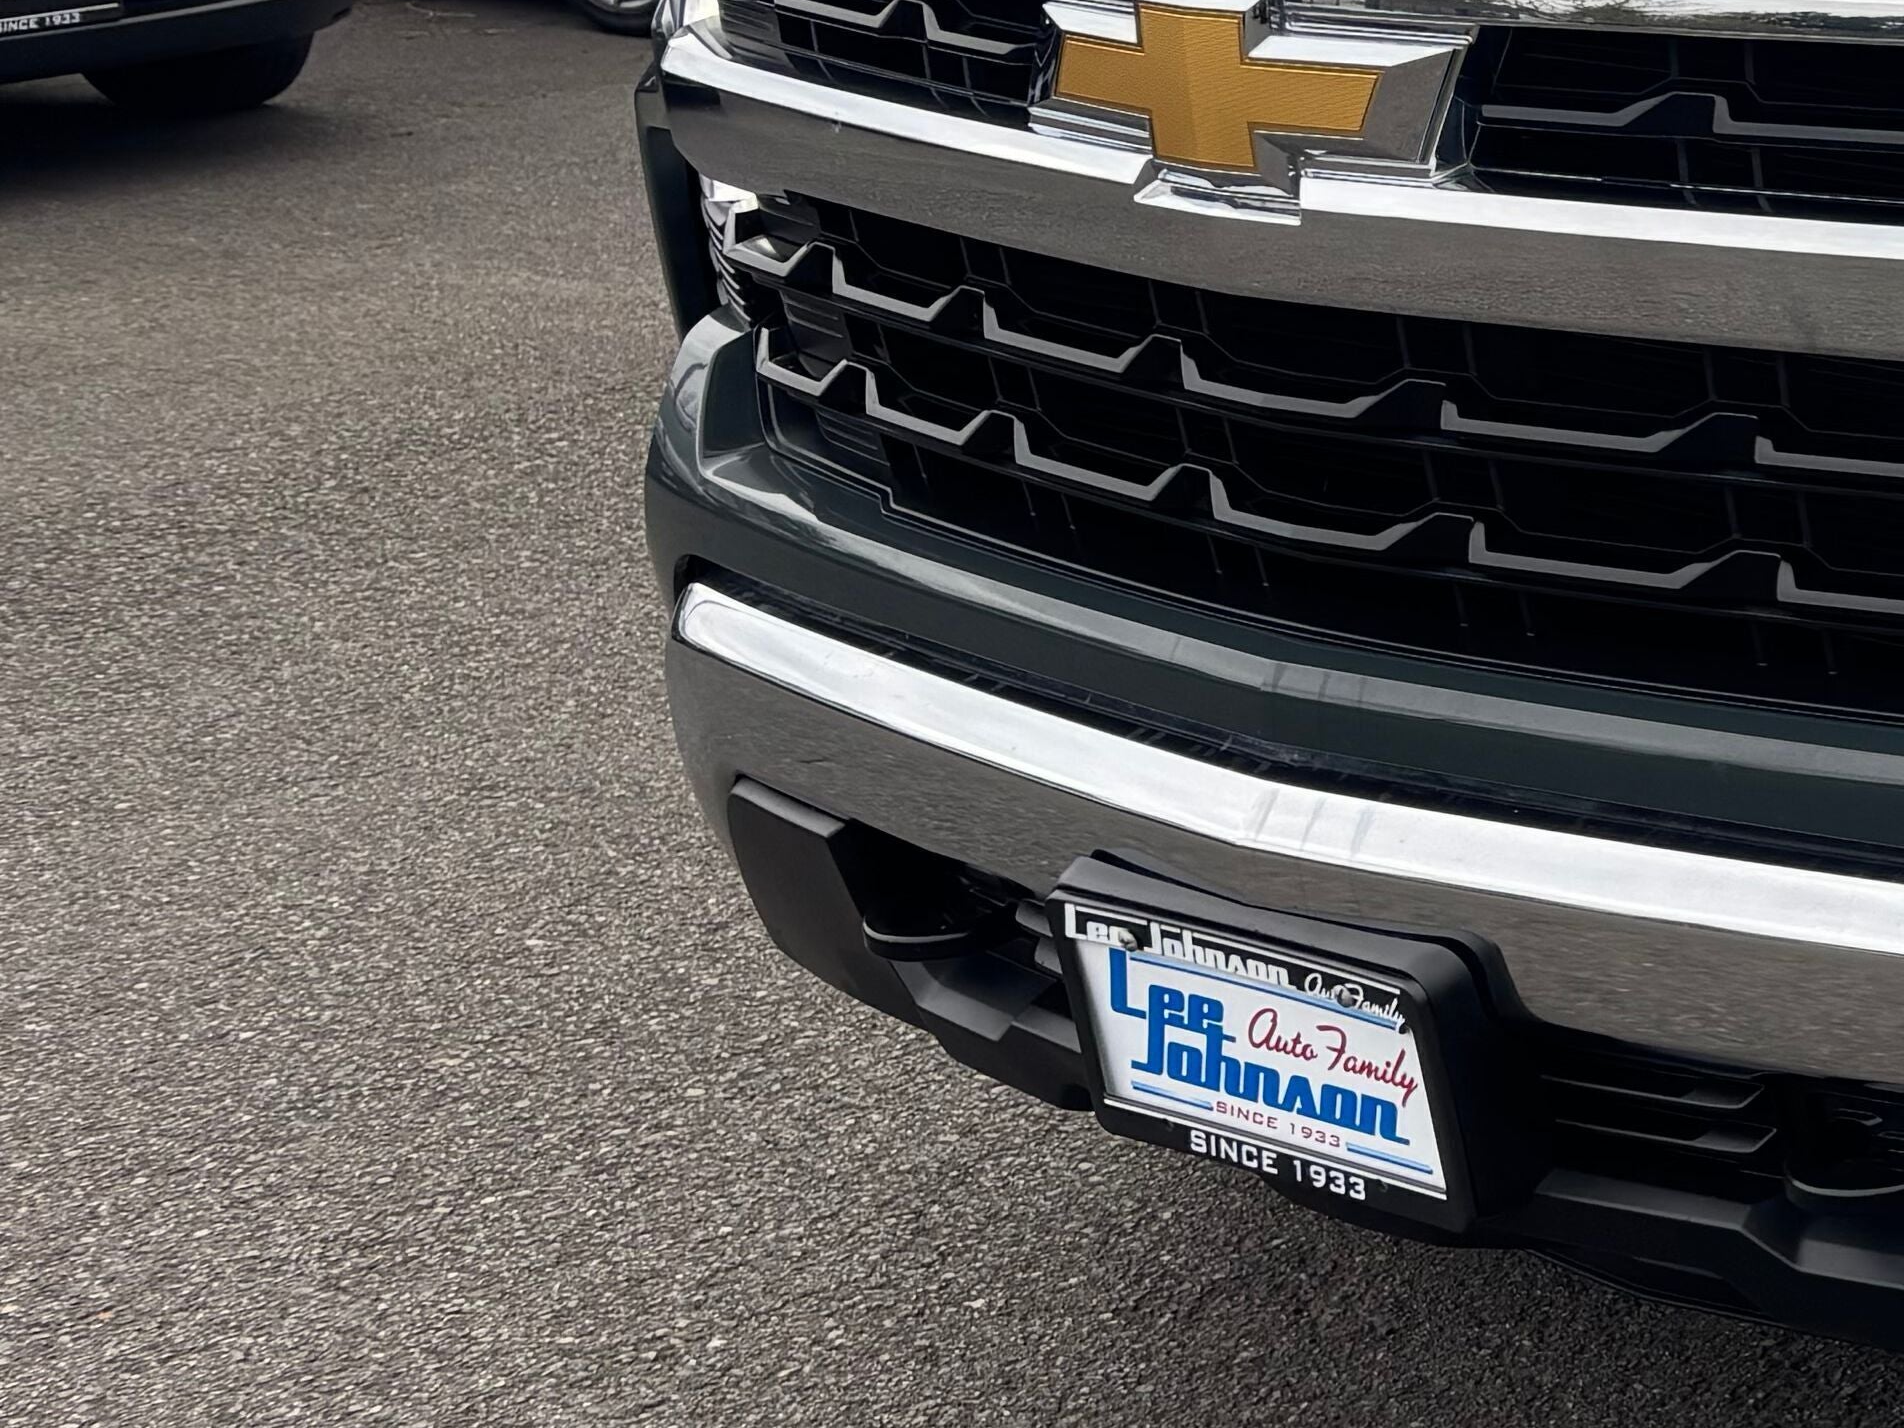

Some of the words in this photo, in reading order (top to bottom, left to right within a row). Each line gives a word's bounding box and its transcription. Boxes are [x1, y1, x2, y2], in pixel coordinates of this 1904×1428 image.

[1109, 948, 1236, 1043] Lee
[1143, 922, 1298, 992] Johnson
[1131, 1022, 1410, 1146] Johnson
[1248, 1008, 1318, 1060] Auto
[1316, 1024, 1418, 1108] Family
[1190, 1129, 1279, 1176] SINCE
[1292, 1160, 1367, 1201] 1933
[1215, 1100, 1278, 1131] SINCE
[1289, 1122, 1342, 1148] 1933
